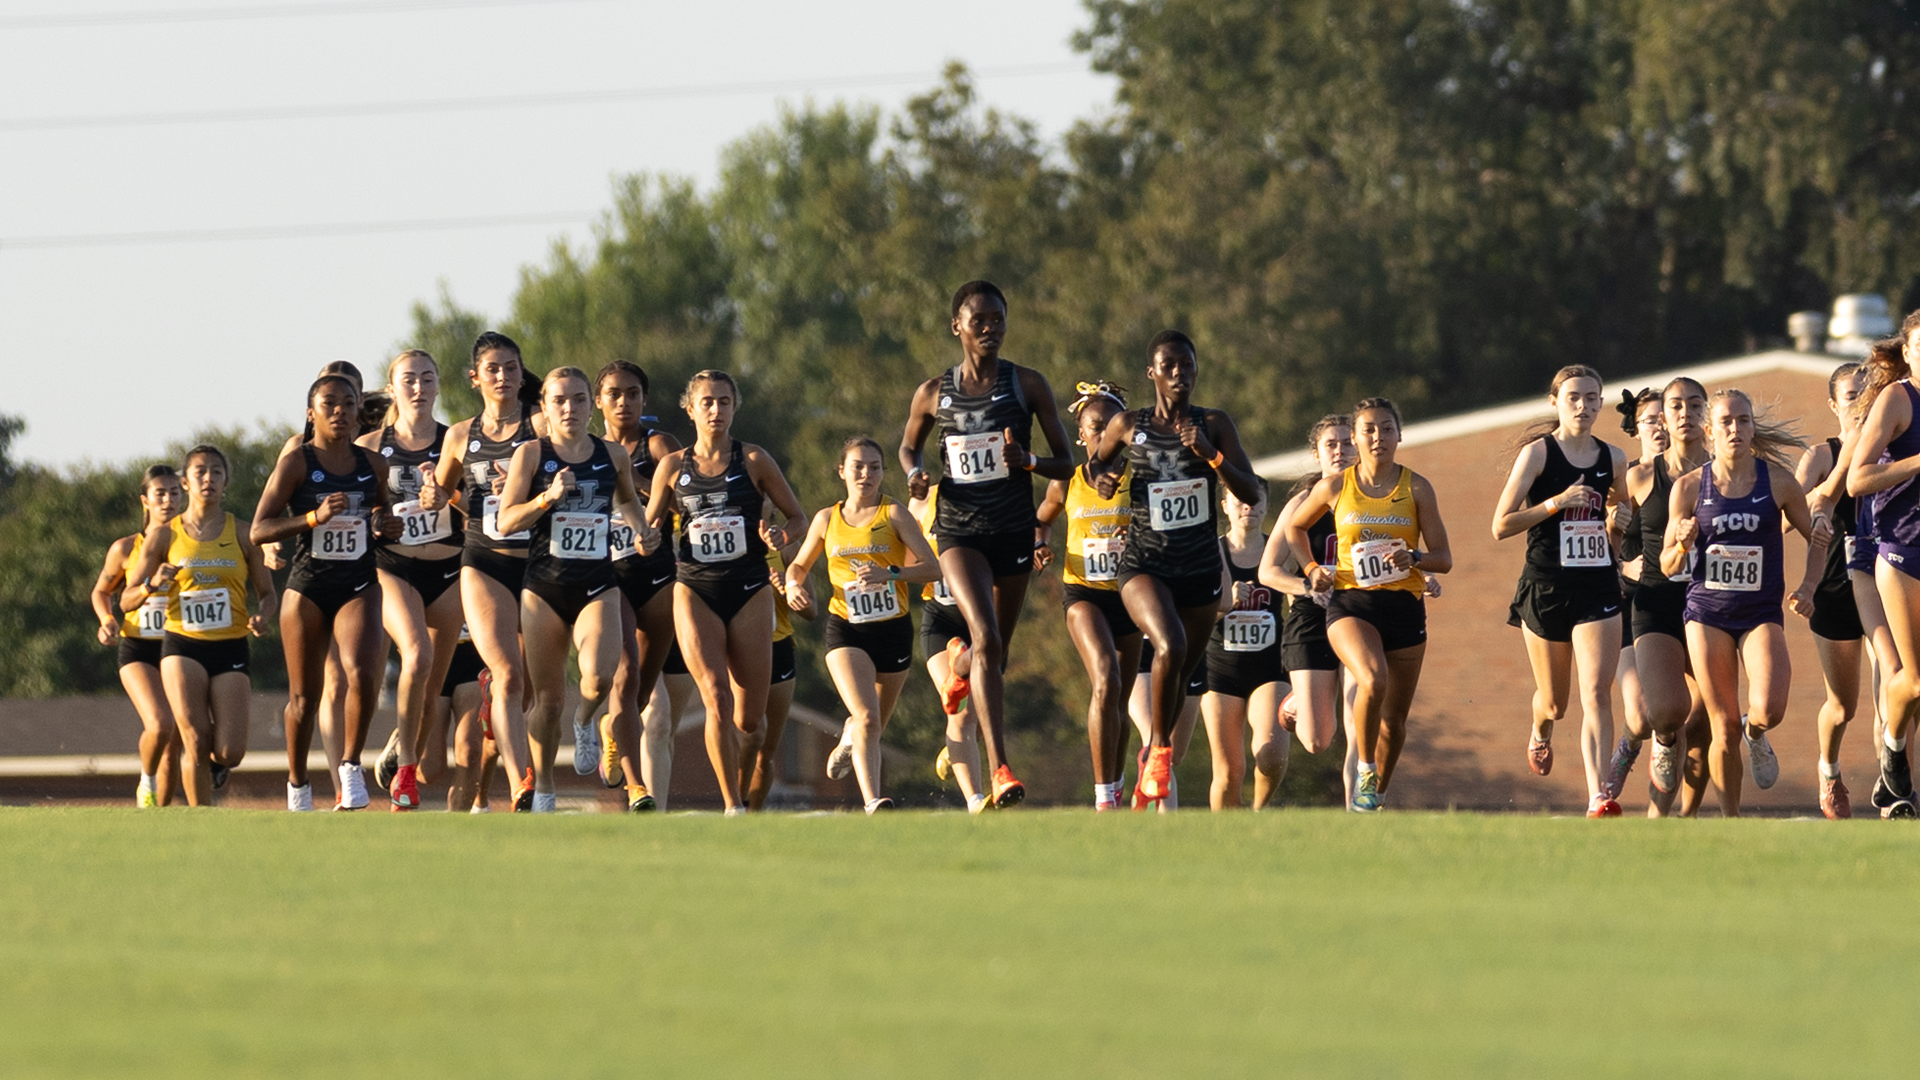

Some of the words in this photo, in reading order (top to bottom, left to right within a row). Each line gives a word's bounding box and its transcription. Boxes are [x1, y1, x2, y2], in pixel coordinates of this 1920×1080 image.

[959, 448, 996, 475] 814
[1146, 450, 1190, 481] UK
[1161, 494, 1199, 522] 820
[1340, 511, 1411, 525] Midwestern
[407, 511, 440, 538] 817
[1712, 512, 1760, 535] TCU
[323, 531, 357, 553] 815
[562, 527, 596, 552] 821
[611, 526, 634, 551] 82
[701, 532, 735, 555] 818
[829, 541, 890, 557] Midwestern
[1566, 536, 1605, 559] 1198
[1088, 552, 1120, 575] 103
[1358, 555, 1393, 580] 104
[1888, 552, 1904, 563] TCU
[1710, 560, 1758, 584] 1648
[185, 602, 226, 624] 1047
[850, 590, 895, 616] 1046
[144, 610, 163, 631] 10
[1229, 624, 1271, 645] 1197
